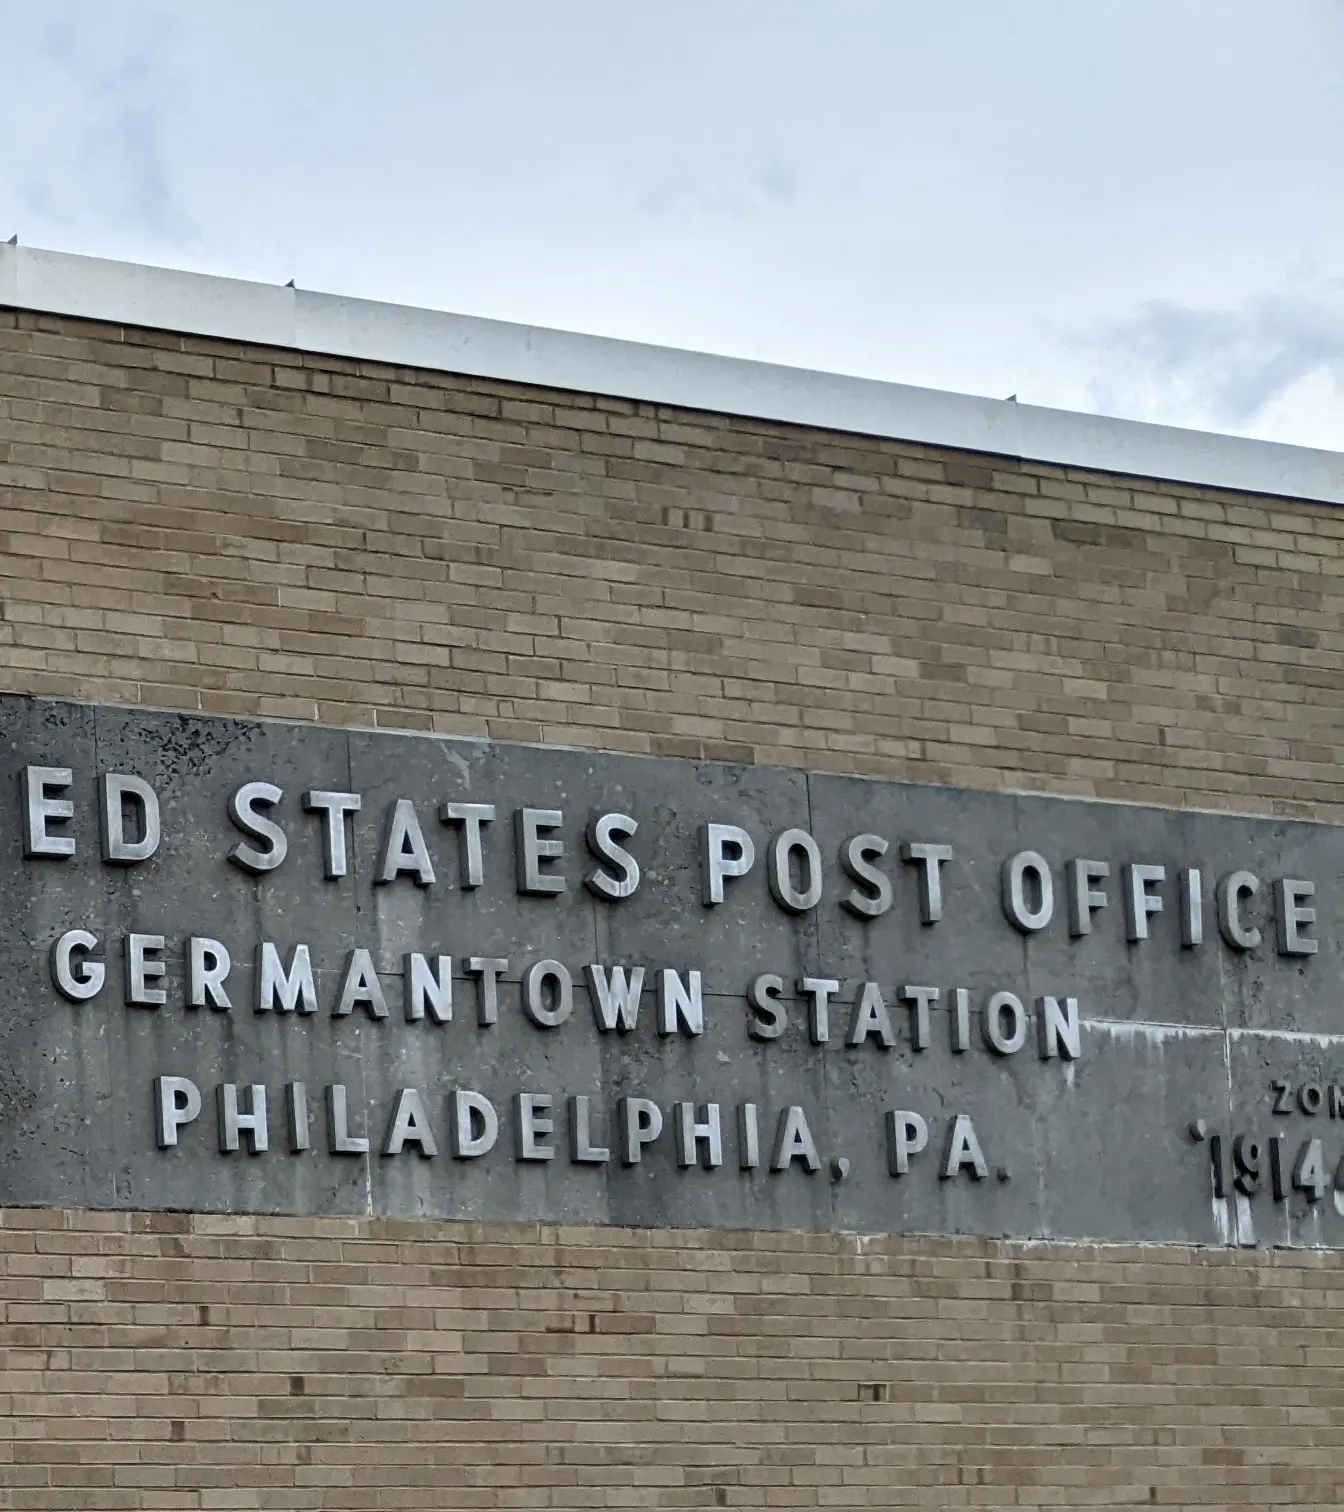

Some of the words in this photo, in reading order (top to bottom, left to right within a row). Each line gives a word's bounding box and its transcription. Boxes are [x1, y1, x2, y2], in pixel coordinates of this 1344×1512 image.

[226, 781, 641, 902] STATES
[700, 822, 954, 927] POST
[1001, 849, 1319, 957] OFFICE
[50, 928, 705, 1038] GERMANTOWN
[747, 973, 1081, 1062] STATION
